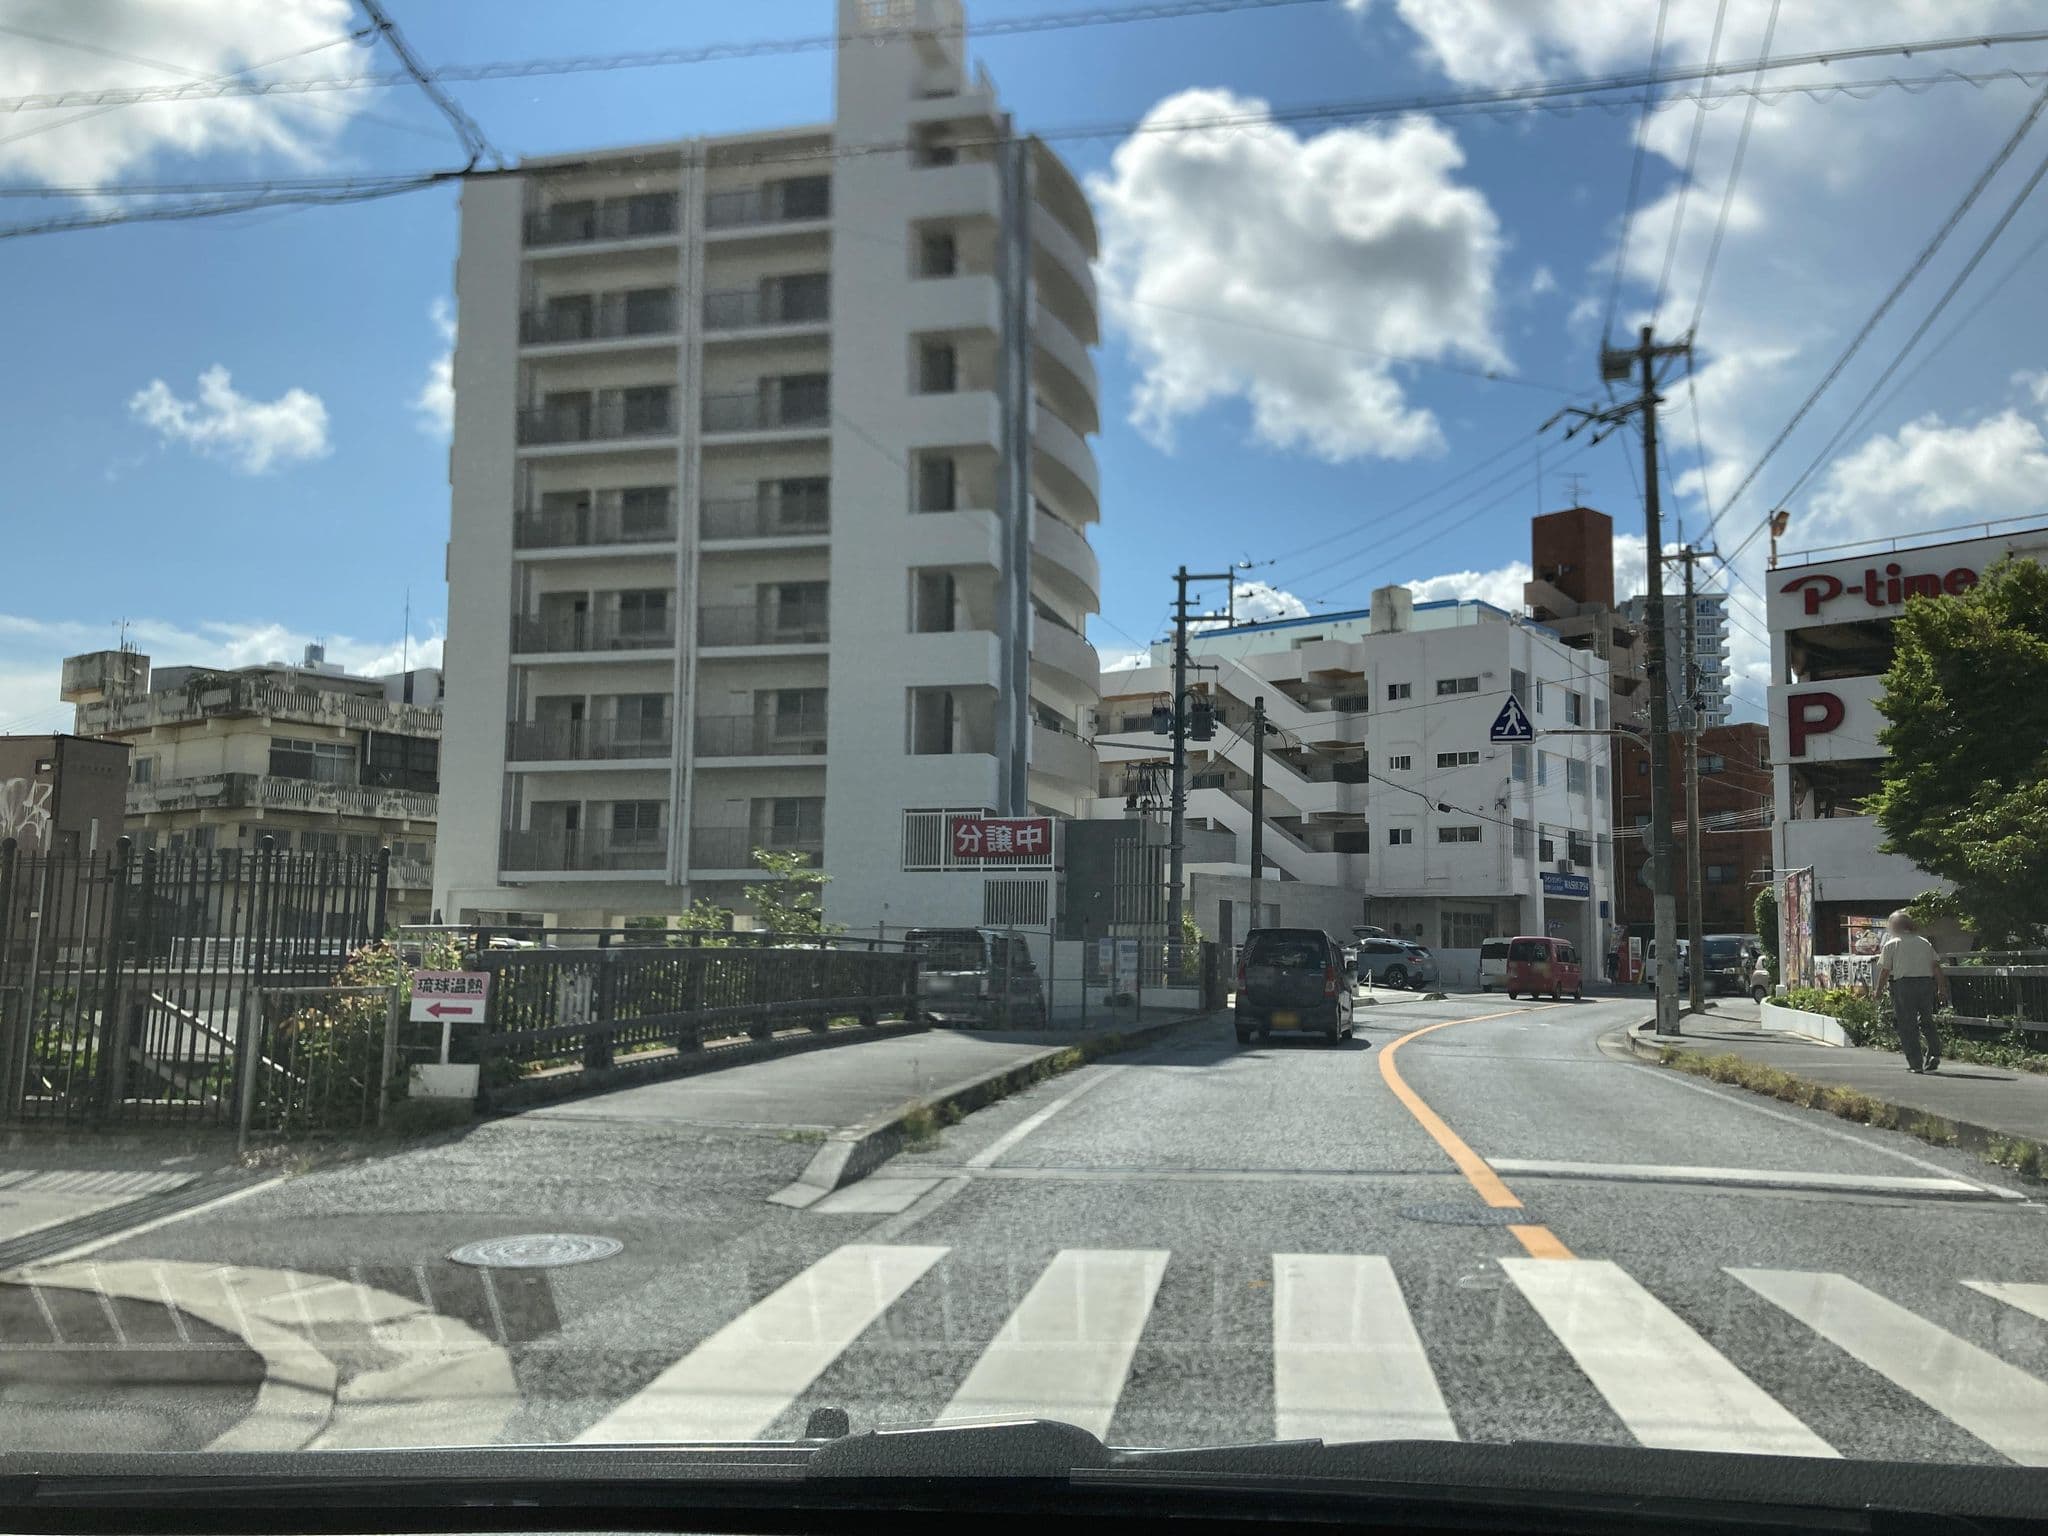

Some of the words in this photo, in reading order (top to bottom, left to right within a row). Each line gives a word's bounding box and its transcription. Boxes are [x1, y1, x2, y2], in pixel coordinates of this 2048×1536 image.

[1787, 691, 1846, 758] P
[956, 824, 1042, 853] 分譲中
[418, 977, 483, 994] 琉球温熱
